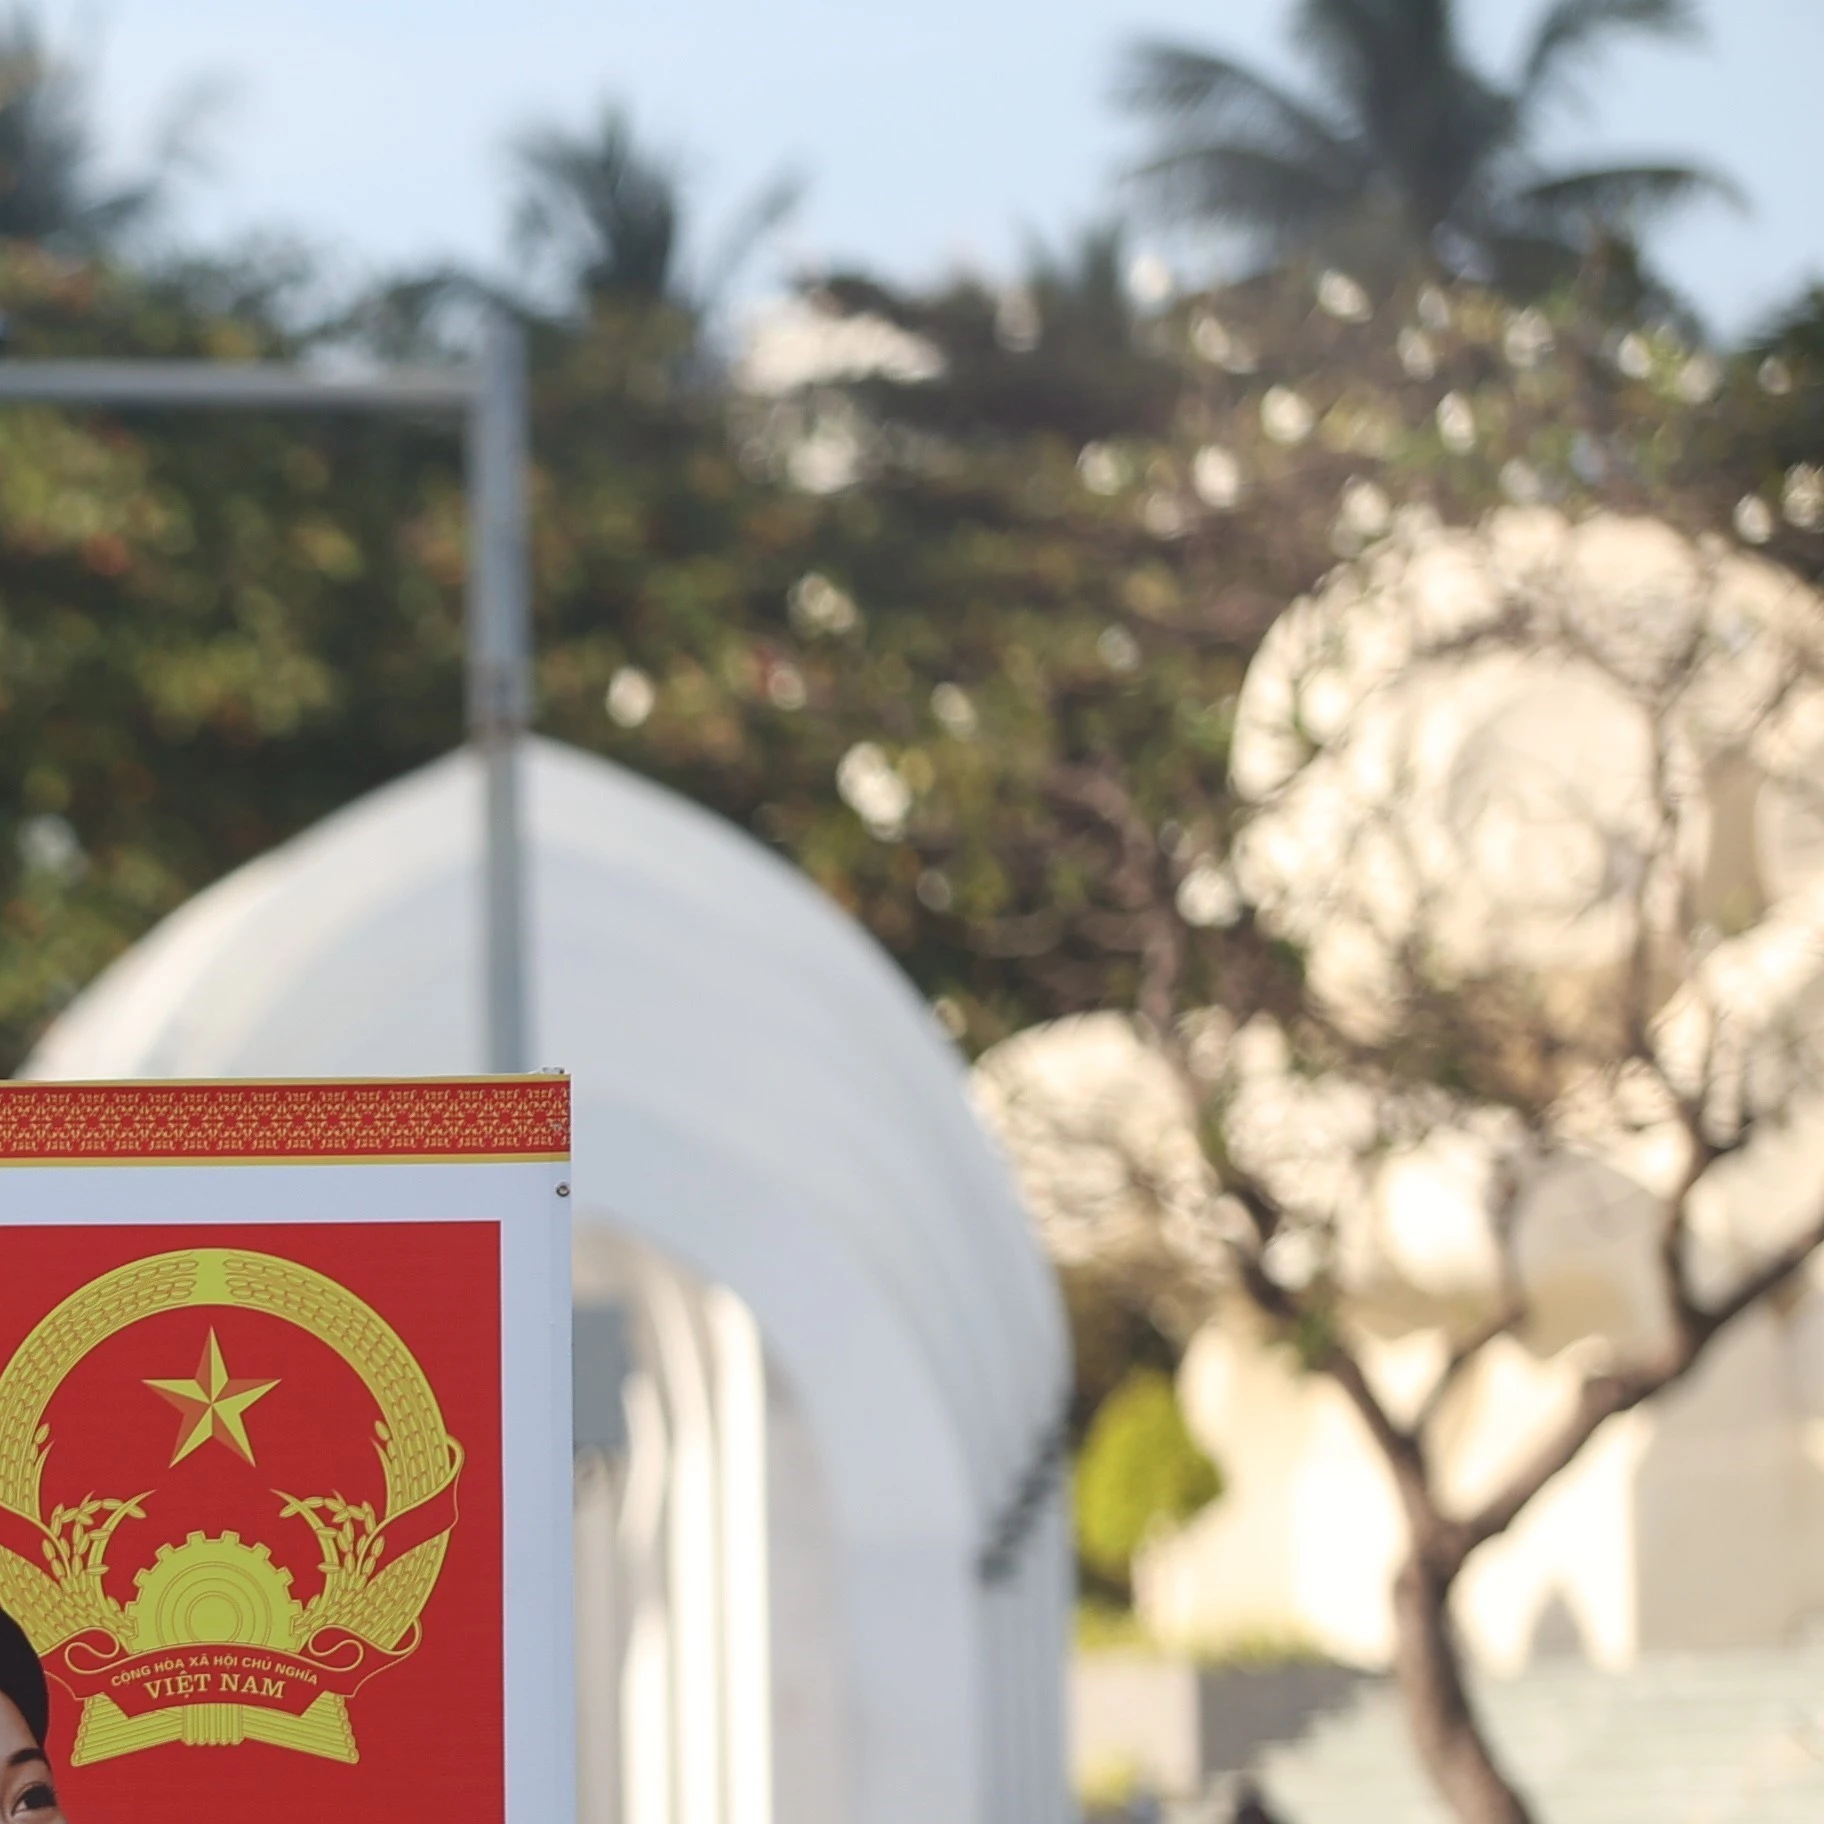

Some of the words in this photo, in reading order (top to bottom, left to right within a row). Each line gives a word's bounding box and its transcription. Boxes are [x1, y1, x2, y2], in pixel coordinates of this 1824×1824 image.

[111, 1666, 151, 1687] CỘNG
[154, 1657, 185, 1673] HÒA
[189, 1653, 210, 1667] XÃ
[214, 1653, 238, 1669] HỘI
[242, 1656, 272, 1671] CHỦ
[274, 1663, 318, 1686] NGHĨA
[144, 1670, 211, 1699] VIỆT
[220, 1673, 286, 1699] NAM
